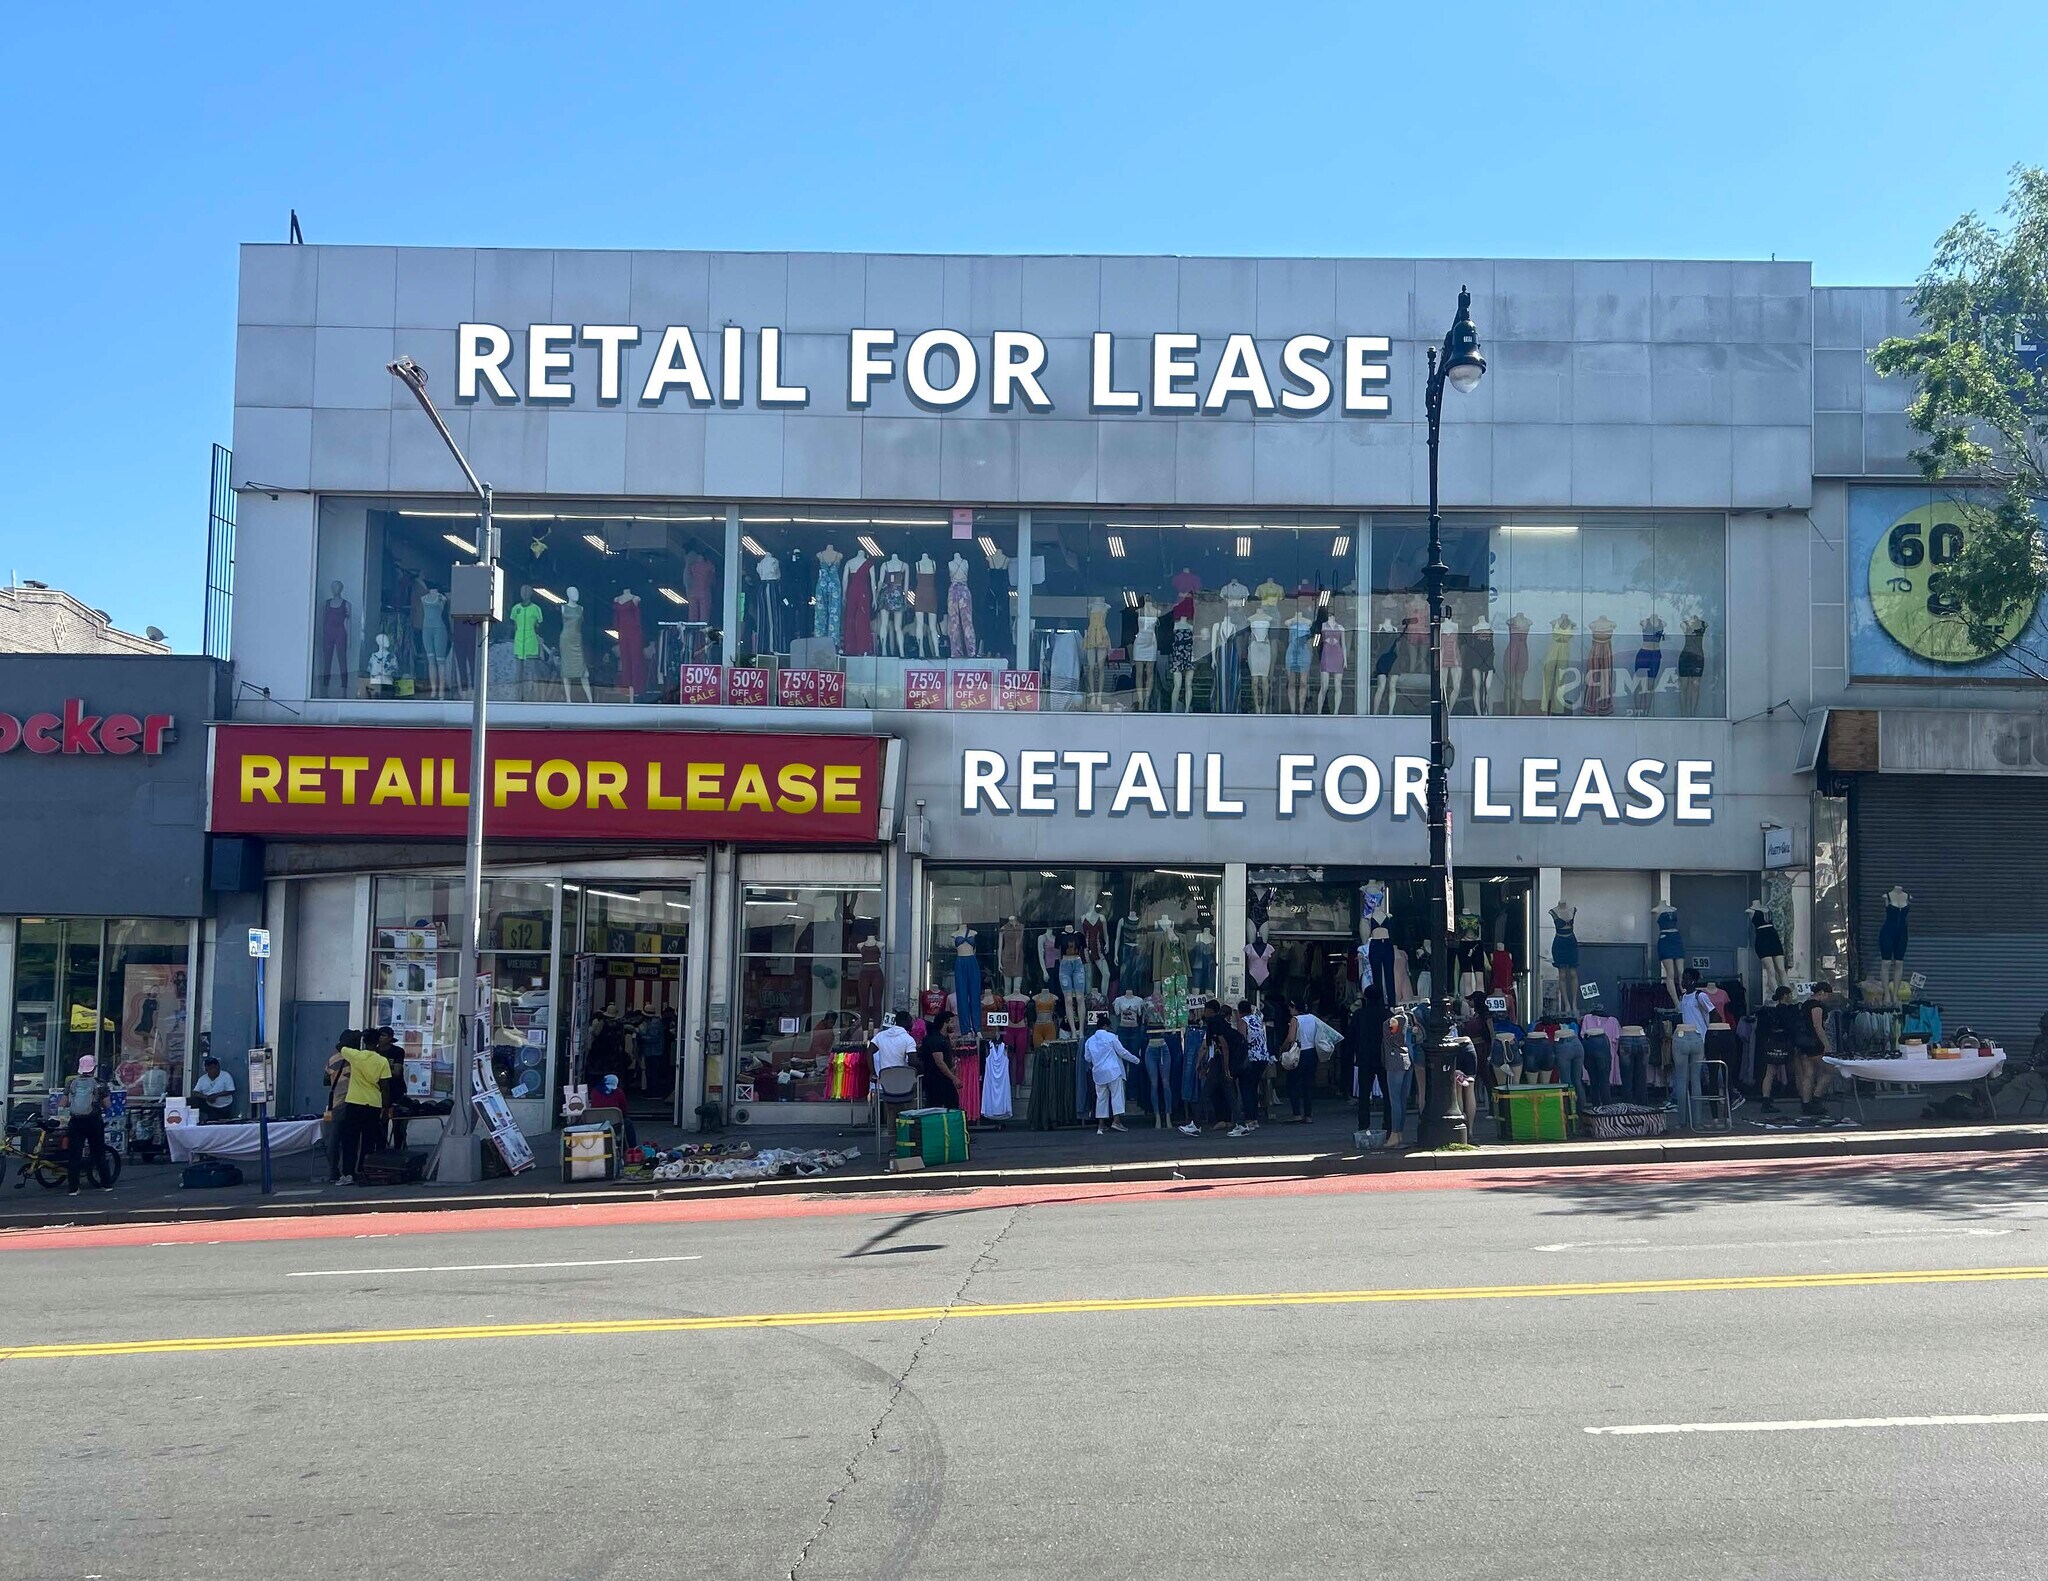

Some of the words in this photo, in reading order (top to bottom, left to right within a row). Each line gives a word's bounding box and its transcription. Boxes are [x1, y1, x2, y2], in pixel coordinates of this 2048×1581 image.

[457, 322, 808, 406] RETAIL
[849, 327, 1054, 411] FOR
[1090, 332, 1393, 412] LEASE
[1886, 577, 1912, 593] TO
[686, 667, 717, 685] 50%
[732, 670, 764, 689] 50%
[783, 672, 815, 690] 75%
[819, 673, 839, 692] 5%
[910, 672, 941, 690] 75%
[957, 672, 988, 690] 75%
[1004, 674, 1034, 691] 50%
[684, 686, 702, 694] OFF
[689, 689, 716, 705] SALE
[731, 689, 749, 697] OFF
[783, 690, 800, 699] OFF
[909, 690, 928, 698] OFF
[955, 690, 974, 698] OFF
[1002, 691, 1020, 699] OFF
[736, 692, 764, 706] SALE
[819, 695, 838, 708] ALE
[914, 694, 940, 709] SALE
[960, 694, 987, 709] SALE
[1007, 694, 1034, 710] SALE
[240, 754, 471, 806] RETAIL
[494, 758, 628, 810] FOR
[647, 761, 862, 814] LEASE
[962, 748, 1246, 817] RETAIL
[1277, 753, 1428, 822] FOR
[1472, 757, 1714, 826] LEASE
[1693, 958, 1709, 968] 5.99
[1581, 984, 1598, 997] 3.99
[1486, 999, 1505, 1009] 5.99
[884, 1014, 896, 1026] 3.9
[988, 1014, 1008, 1024] 5.99
